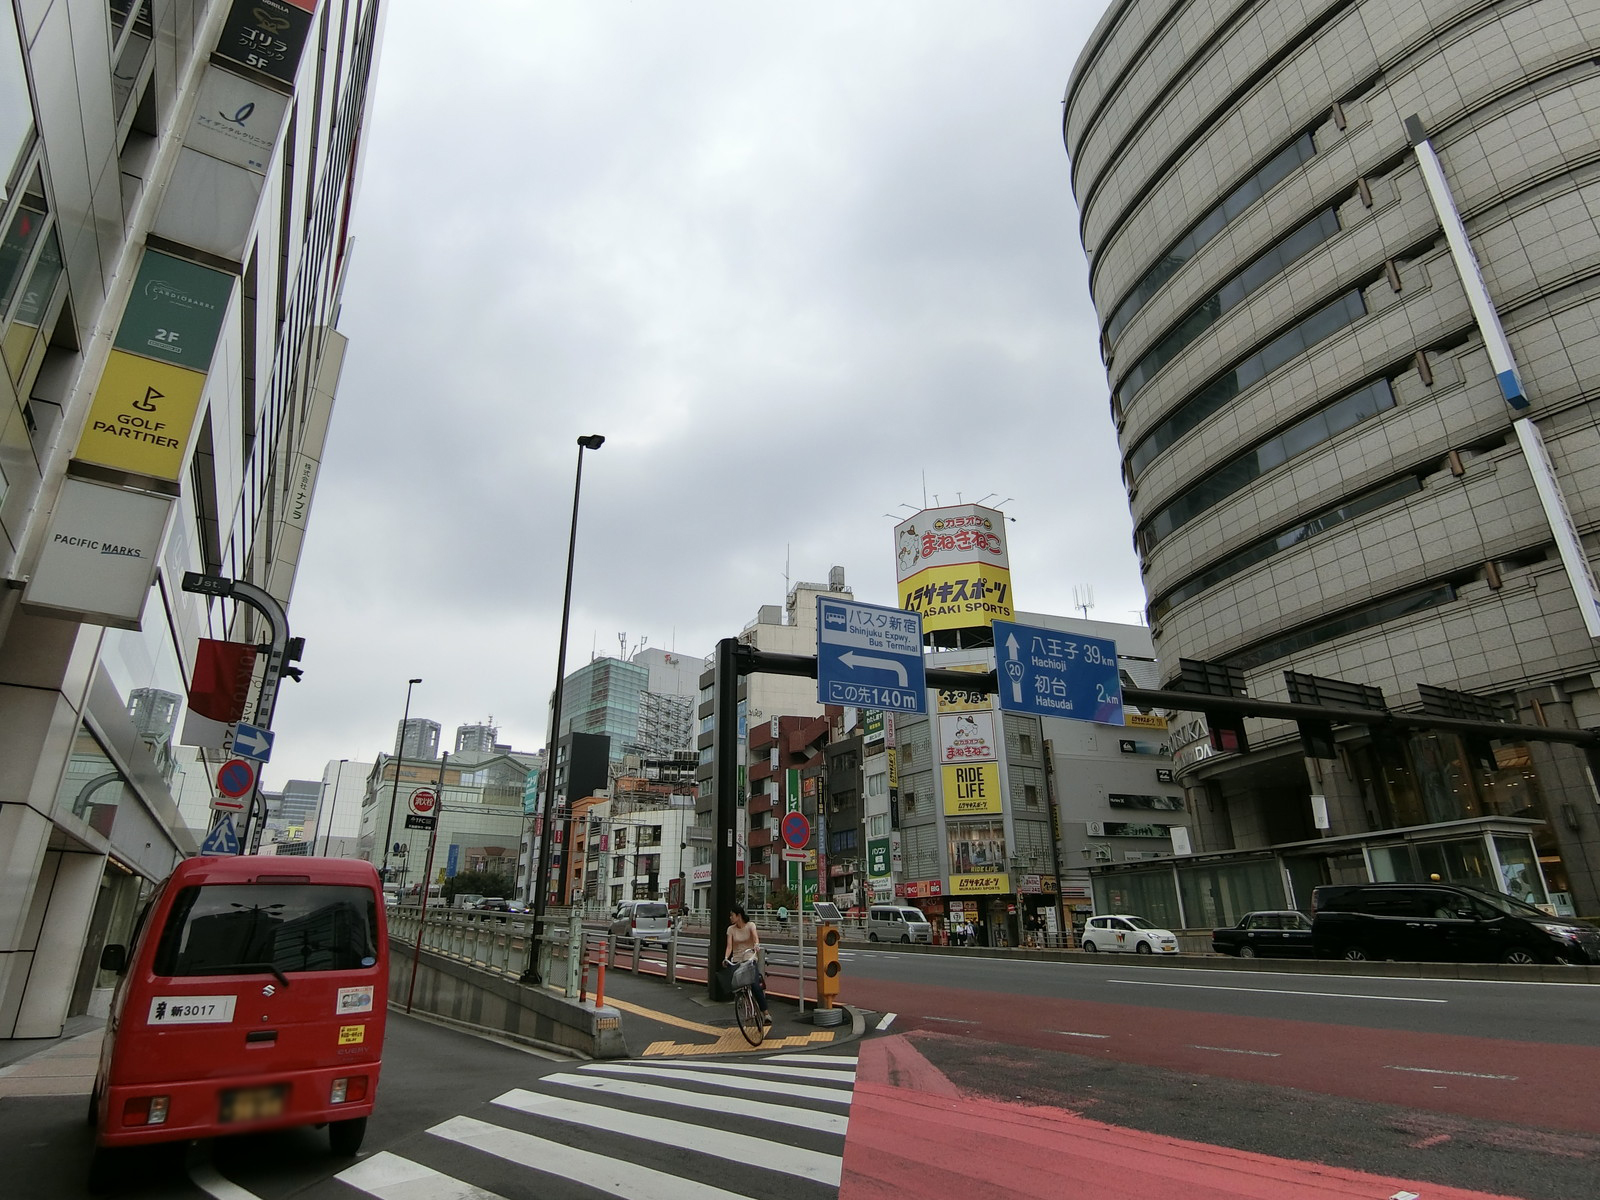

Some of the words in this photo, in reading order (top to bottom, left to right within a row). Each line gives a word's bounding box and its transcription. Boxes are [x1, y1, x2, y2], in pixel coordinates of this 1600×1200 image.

[240, 26, 287, 52] ゴリラ
[239, 38, 285, 61] クリニック
[246, 54, 268, 69] 5F
[153, 287, 215, 309] CARDIOBARRE
[154, 328, 180, 342] 2F
[117, 414, 166, 431] GOLF
[93, 421, 179, 449] PARTNER
[945, 515, 984, 528] カラオケ
[54, 533, 99, 550] PACIFIC
[101, 543, 141, 558] MARKS
[921, 530, 1002, 559] まねきねこ
[904, 578, 1007, 612] ムラサキスポーツ
[922, 605, 961, 620] ASAKI
[966, 602, 1011, 617] SPORTS
[849, 610, 917, 635] バスタ新宿
[849, 625, 883, 641] Shinjuku
[885, 631, 911, 644] Expwy.
[869, 637, 883, 648] Bus
[886, 641, 918, 654] Terminal
[1031, 636, 1079, 660] 八王子
[1009, 664, 1022, 677] 20
[1031, 655, 1068, 673] Hachioji
[1034, 674, 1068, 697] 初台
[1036, 695, 1074, 711] Hatsudai
[946, 746, 991, 760] まねきねこ
[956, 766, 984, 783] RIDE
[957, 783, 986, 799] LIFE
[415, 797, 434, 807] 消火栓
[871, 847, 887, 855] パソコン
[959, 878, 999, 887] ムラサキスポーツ
